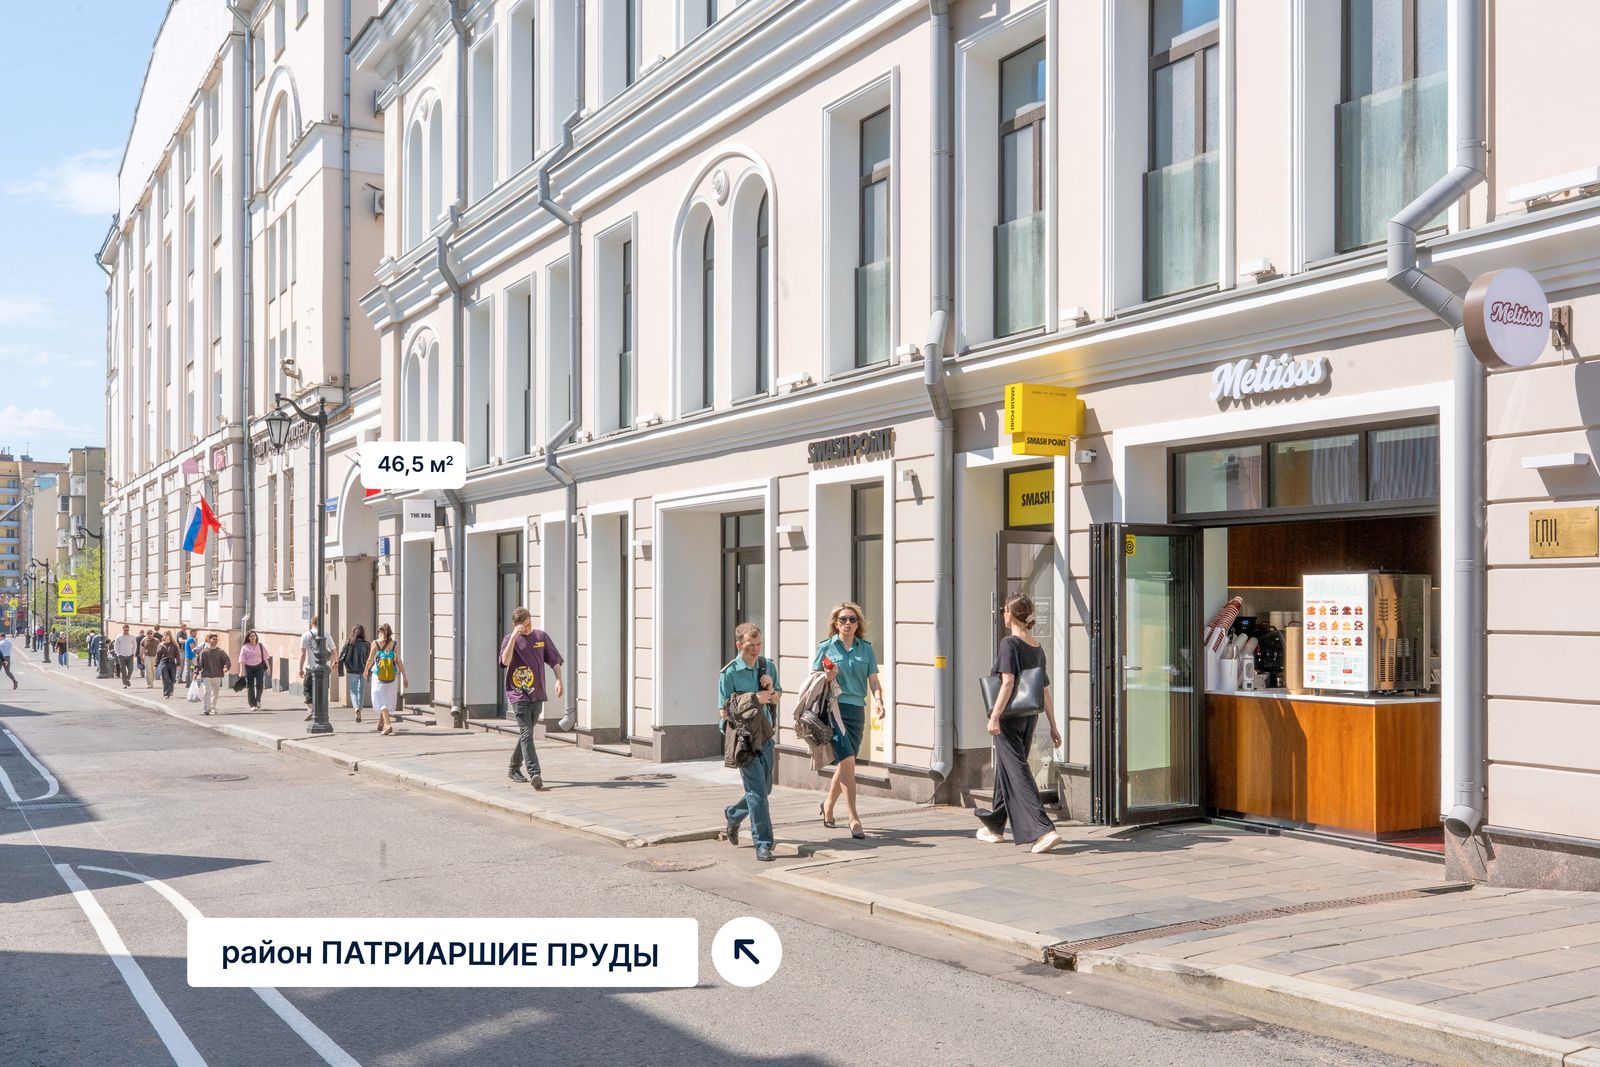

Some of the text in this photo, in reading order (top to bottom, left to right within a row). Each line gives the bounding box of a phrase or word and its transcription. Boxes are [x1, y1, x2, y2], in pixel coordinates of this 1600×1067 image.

[1490, 301, 1544, 327] Meltisss
[1209, 353, 1328, 401] Meltisss
[808, 436, 850, 463] SMASH
[1026, 436, 1047, 445] SMASH
[1021, 491, 1050, 507] SMASH
